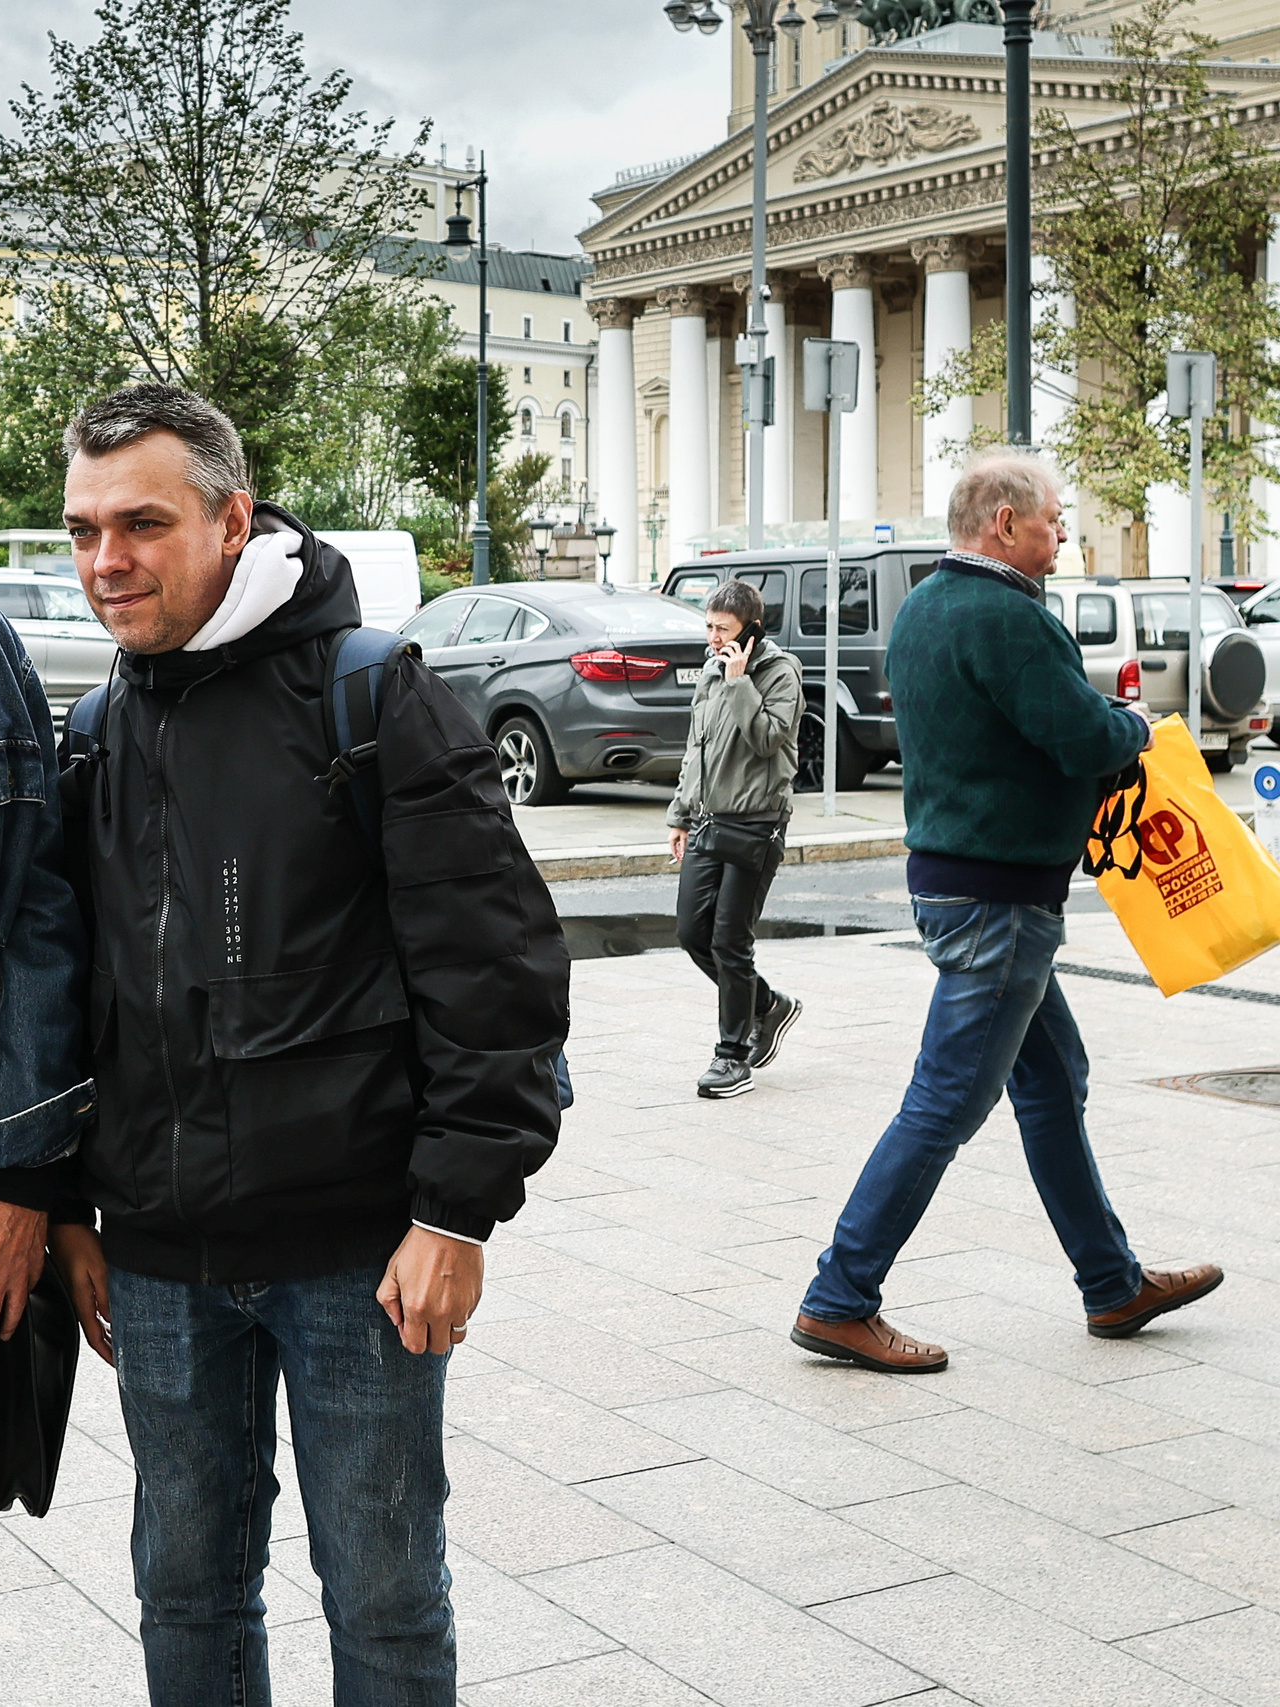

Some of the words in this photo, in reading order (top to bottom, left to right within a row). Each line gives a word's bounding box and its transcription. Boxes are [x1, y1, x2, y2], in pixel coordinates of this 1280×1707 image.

[1160, 858, 1215, 897] РОССИЯ
[1164, 872, 1220, 908] ПАТРИОТЫ
[1169, 906, 1184, 917] ЗА
[1184, 882, 1222, 908] ПРАВДУ
